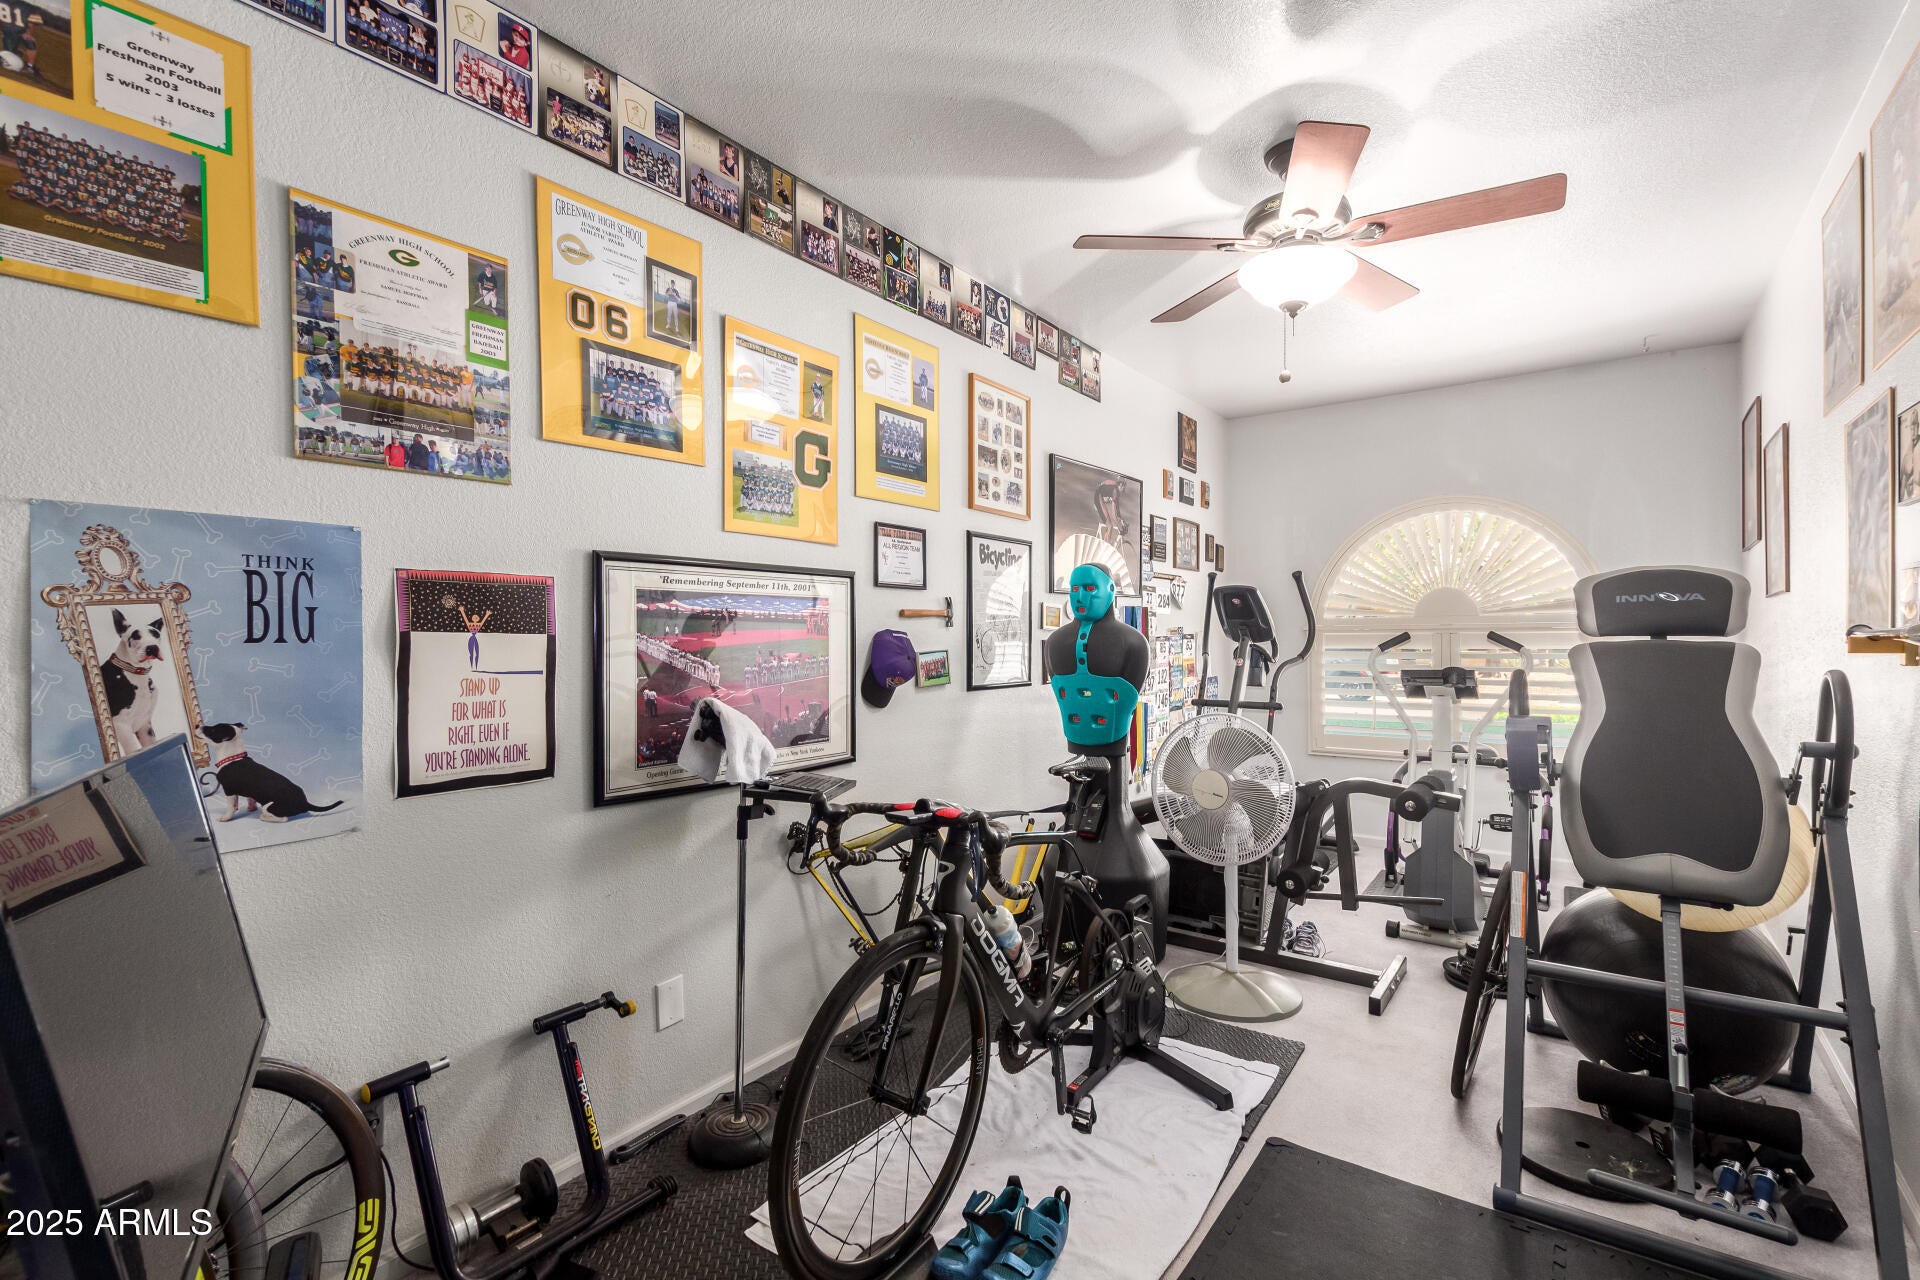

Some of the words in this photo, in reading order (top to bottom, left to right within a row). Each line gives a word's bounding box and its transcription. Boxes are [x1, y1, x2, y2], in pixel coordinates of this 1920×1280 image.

[97, 42, 166, 74] Freshman
[168, 69, 221, 95] Football
[127, 41, 195, 73] Greenway
[105, 72, 115, 82] 5
[118, 78, 151, 95] wins
[166, 94, 174, 103] 3
[177, 98, 216, 118] losses
[145, 73, 179, 92] 2003
[555, 198, 596, 222] GREENWAY
[597, 214, 616, 231] HIGH
[617, 222, 644, 249] SCHOOL
[348, 233, 396, 249] GREENWAY
[398, 237, 423, 252] HIGH
[424, 249, 456, 280] SCHOOL
[387, 249, 420, 267] G
[566, 288, 631, 345] 06
[792, 426, 832, 492] G
[242, 553, 315, 571] THINK
[978, 542, 1023, 571] Bicyclin
[726, 579, 770, 591] September
[1616, 592, 1706, 603] INNOVA
[242, 569, 319, 644] BIG
[1157, 593, 1170, 609] 284
[460, 678, 486, 697] STAND
[488, 677, 501, 696] UP
[452, 702, 470, 721] FOR
[472, 700, 497, 720] WHAT
[499, 699, 507, 719] IS
[448, 724, 476, 746] RIGHT,
[478, 723, 500, 743] EVEN
[502, 722, 510, 741] IF
[425, 749, 457, 773] YOU'RE
[460, 746, 501, 768] STANDING
[503, 743, 531, 764] ALONE.
[970, 912, 1025, 1008] DOGMA
[881, 992, 903, 1051] PINARELLO
